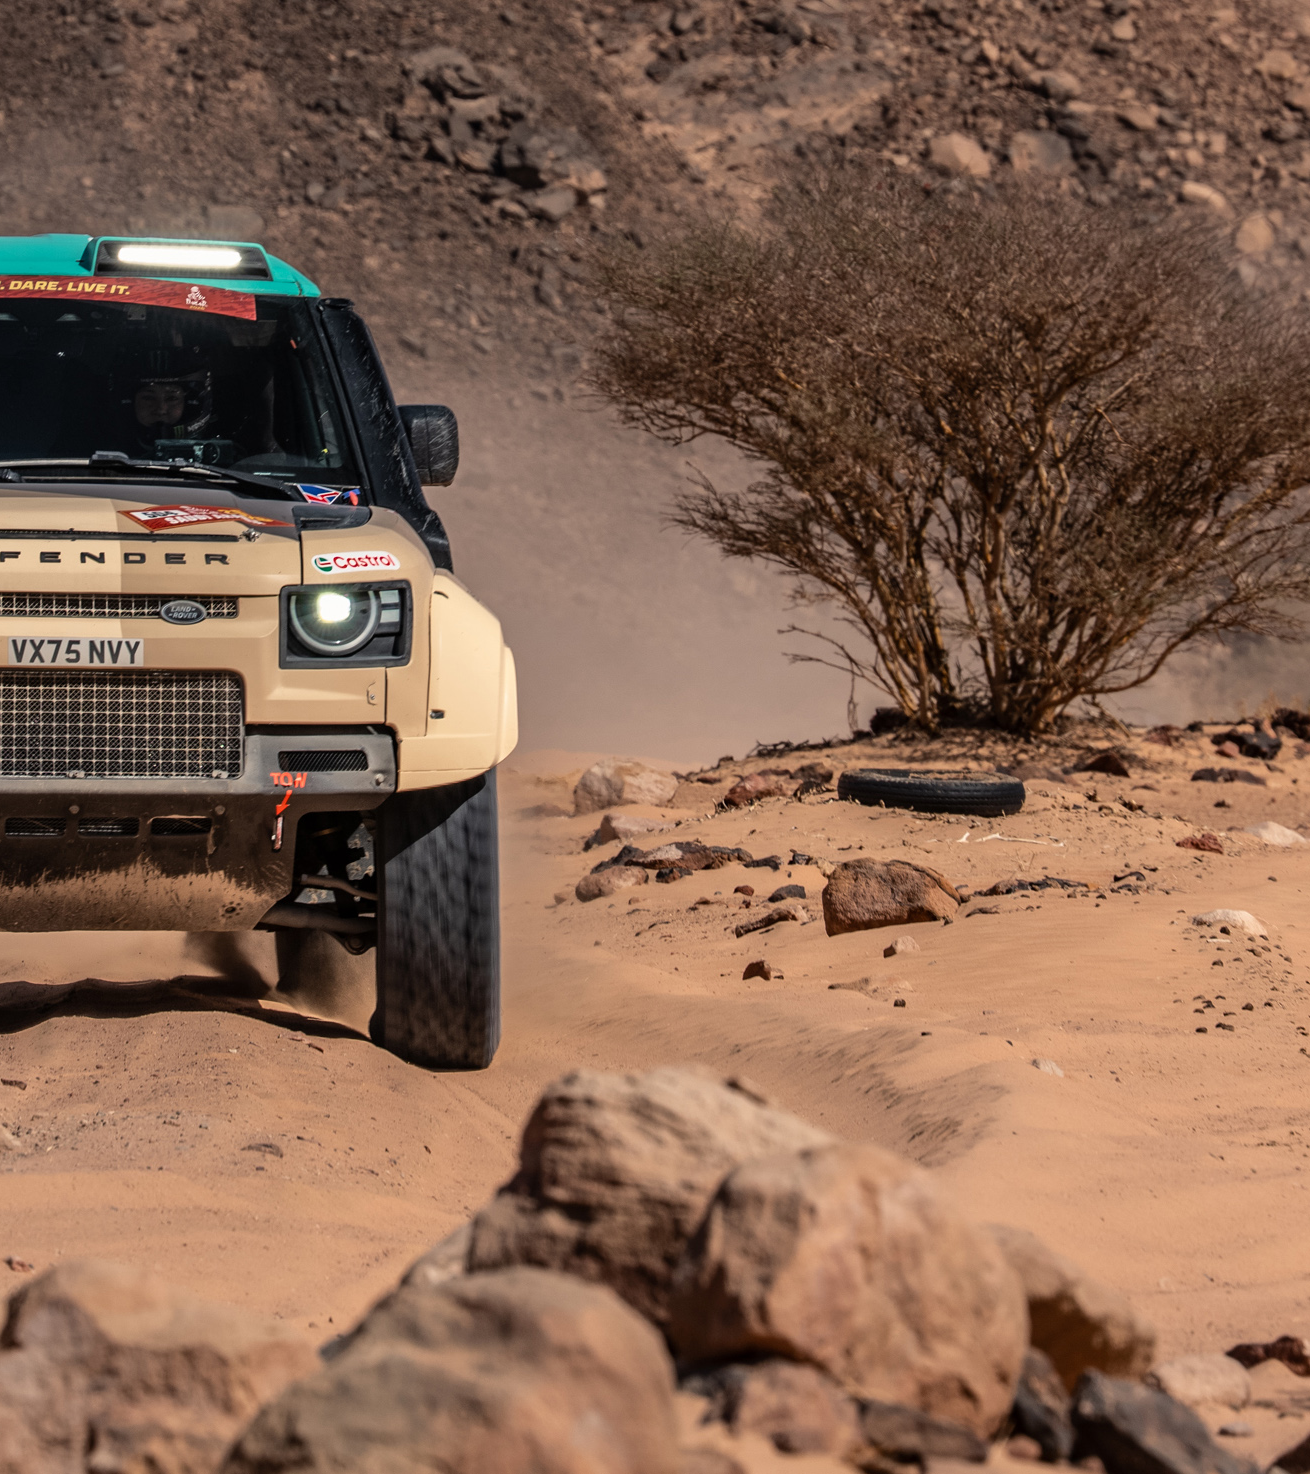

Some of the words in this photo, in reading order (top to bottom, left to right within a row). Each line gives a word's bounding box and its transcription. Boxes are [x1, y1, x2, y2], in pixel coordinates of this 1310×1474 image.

[8, 280, 63, 291] DARE.
[66, 282, 108, 293] LIVE
[109, 284, 131, 295] IT.
[333, 554, 396, 569] Castrol
[11, 639, 81, 664] VX75
[88, 640, 141, 665] NVY
